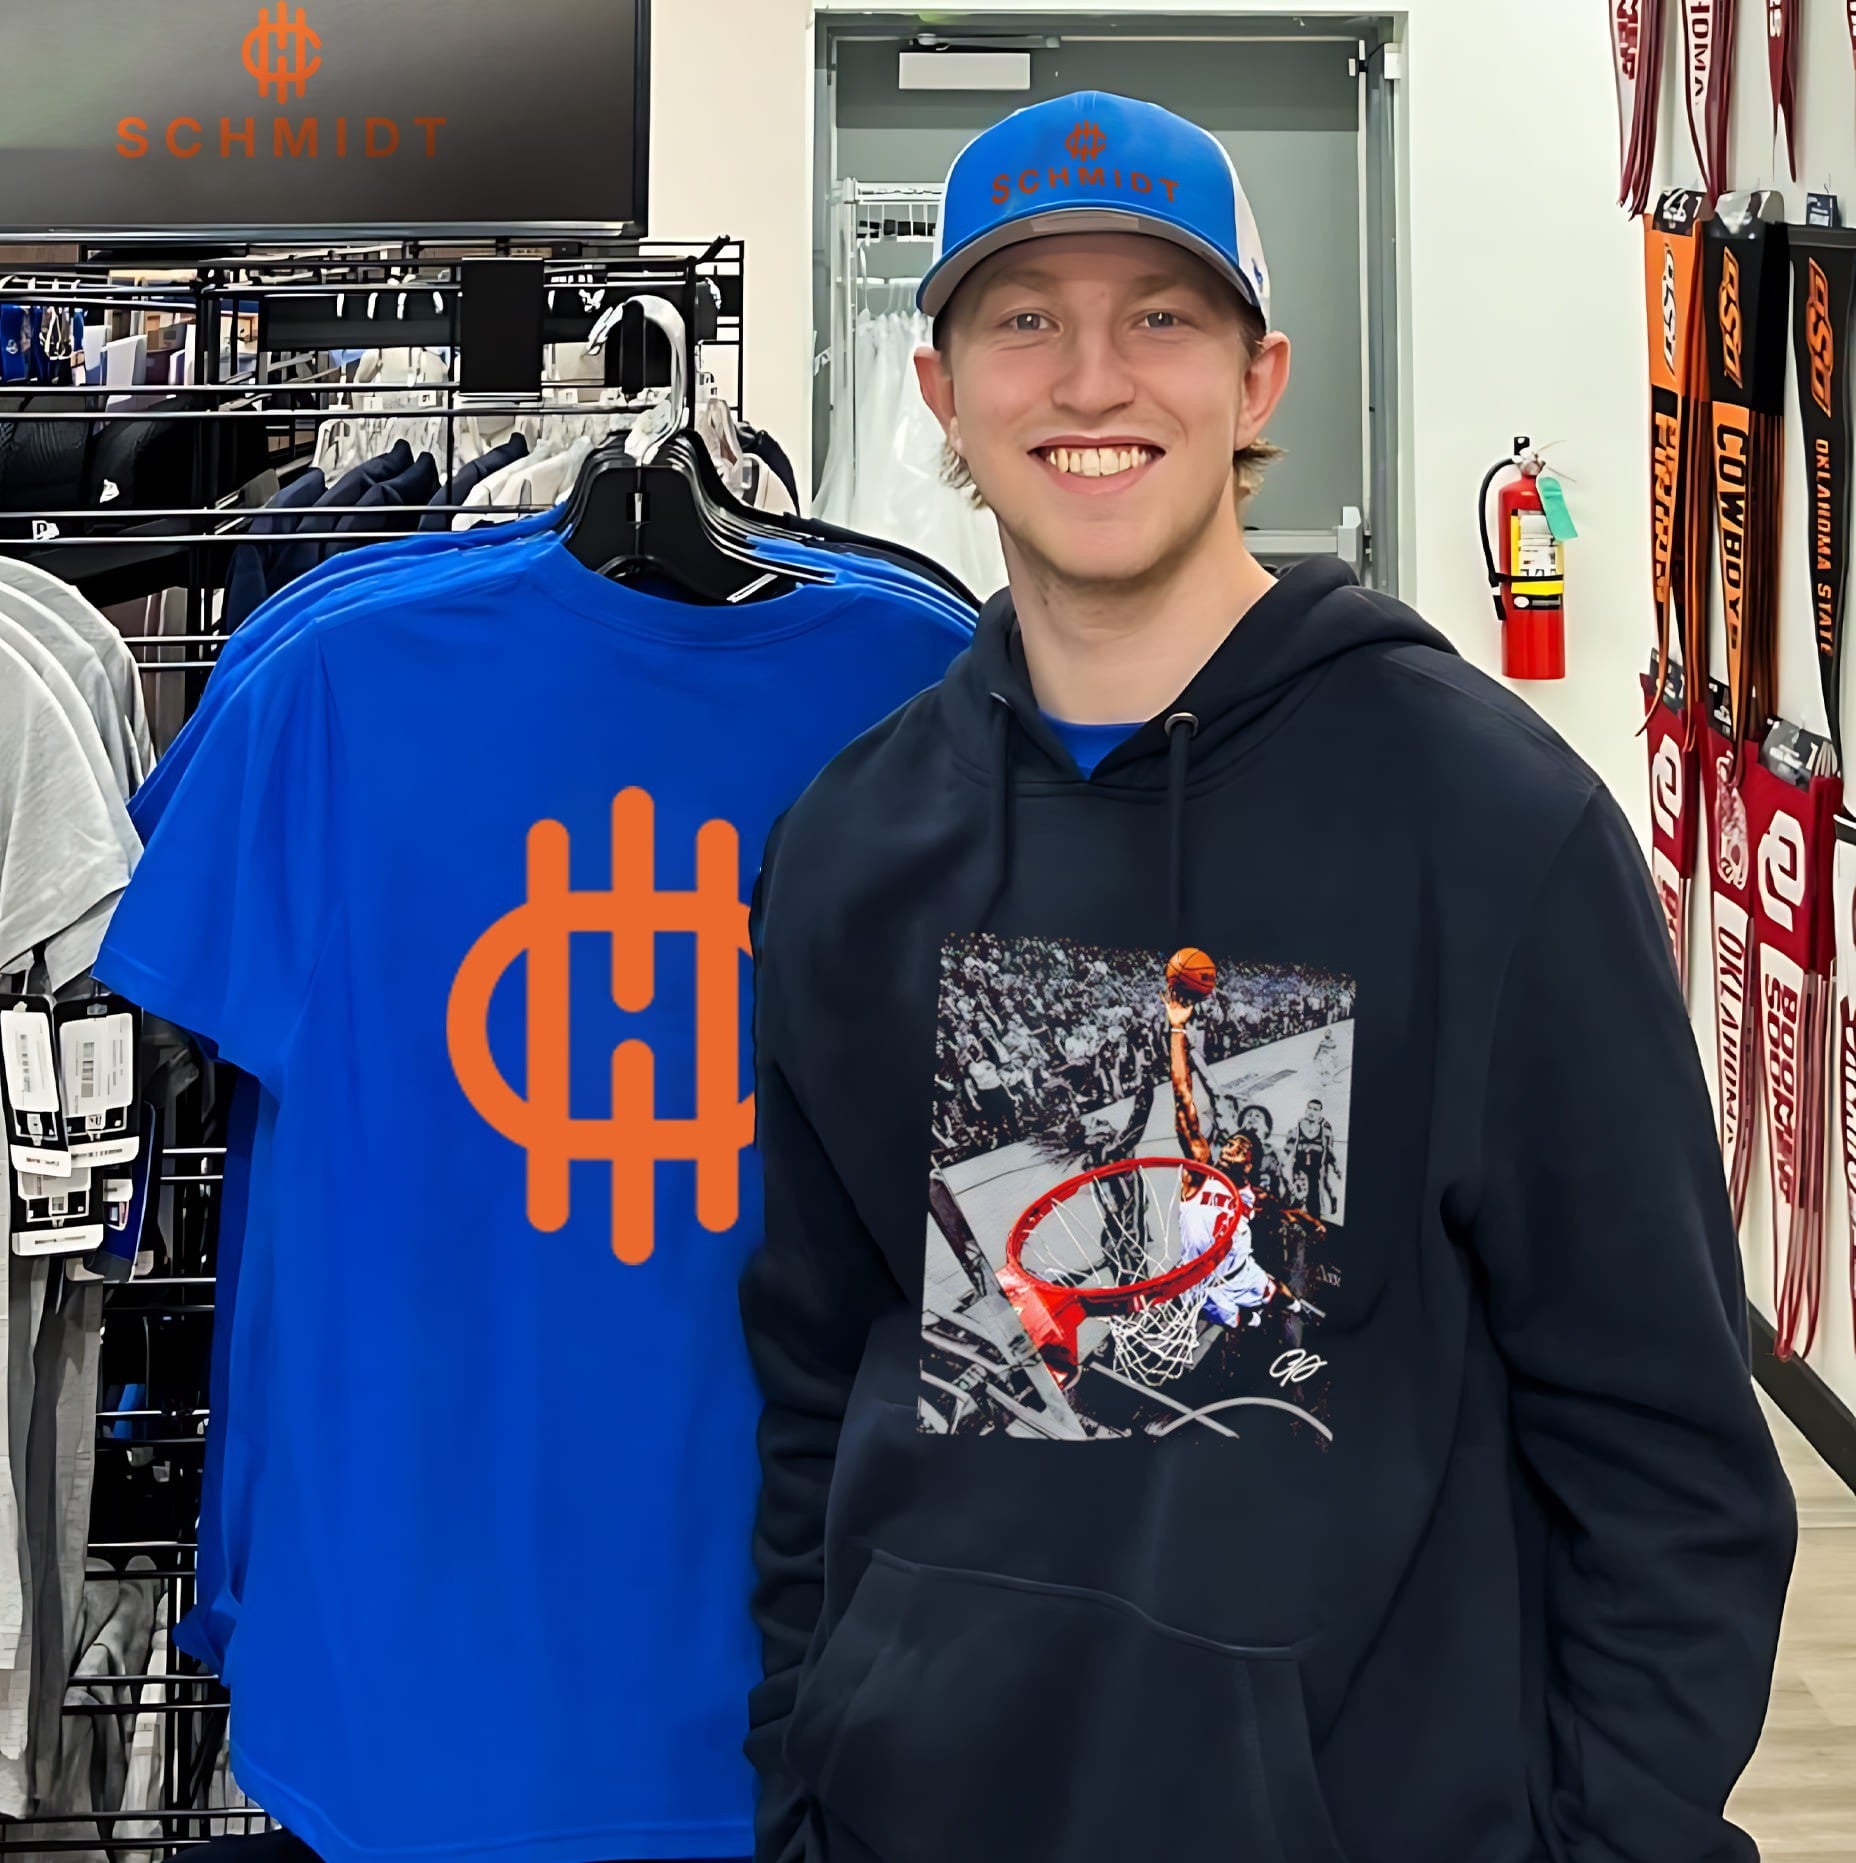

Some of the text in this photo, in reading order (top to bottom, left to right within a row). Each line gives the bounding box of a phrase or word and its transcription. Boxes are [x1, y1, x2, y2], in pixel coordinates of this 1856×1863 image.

[116, 116, 448, 159] SCHMIDT
[991, 166, 1179, 205] SCHMIDT
[1814, 438, 1834, 657] OKLAHOMA STATE
[1718, 925, 1745, 1144] OKLAHOMA
